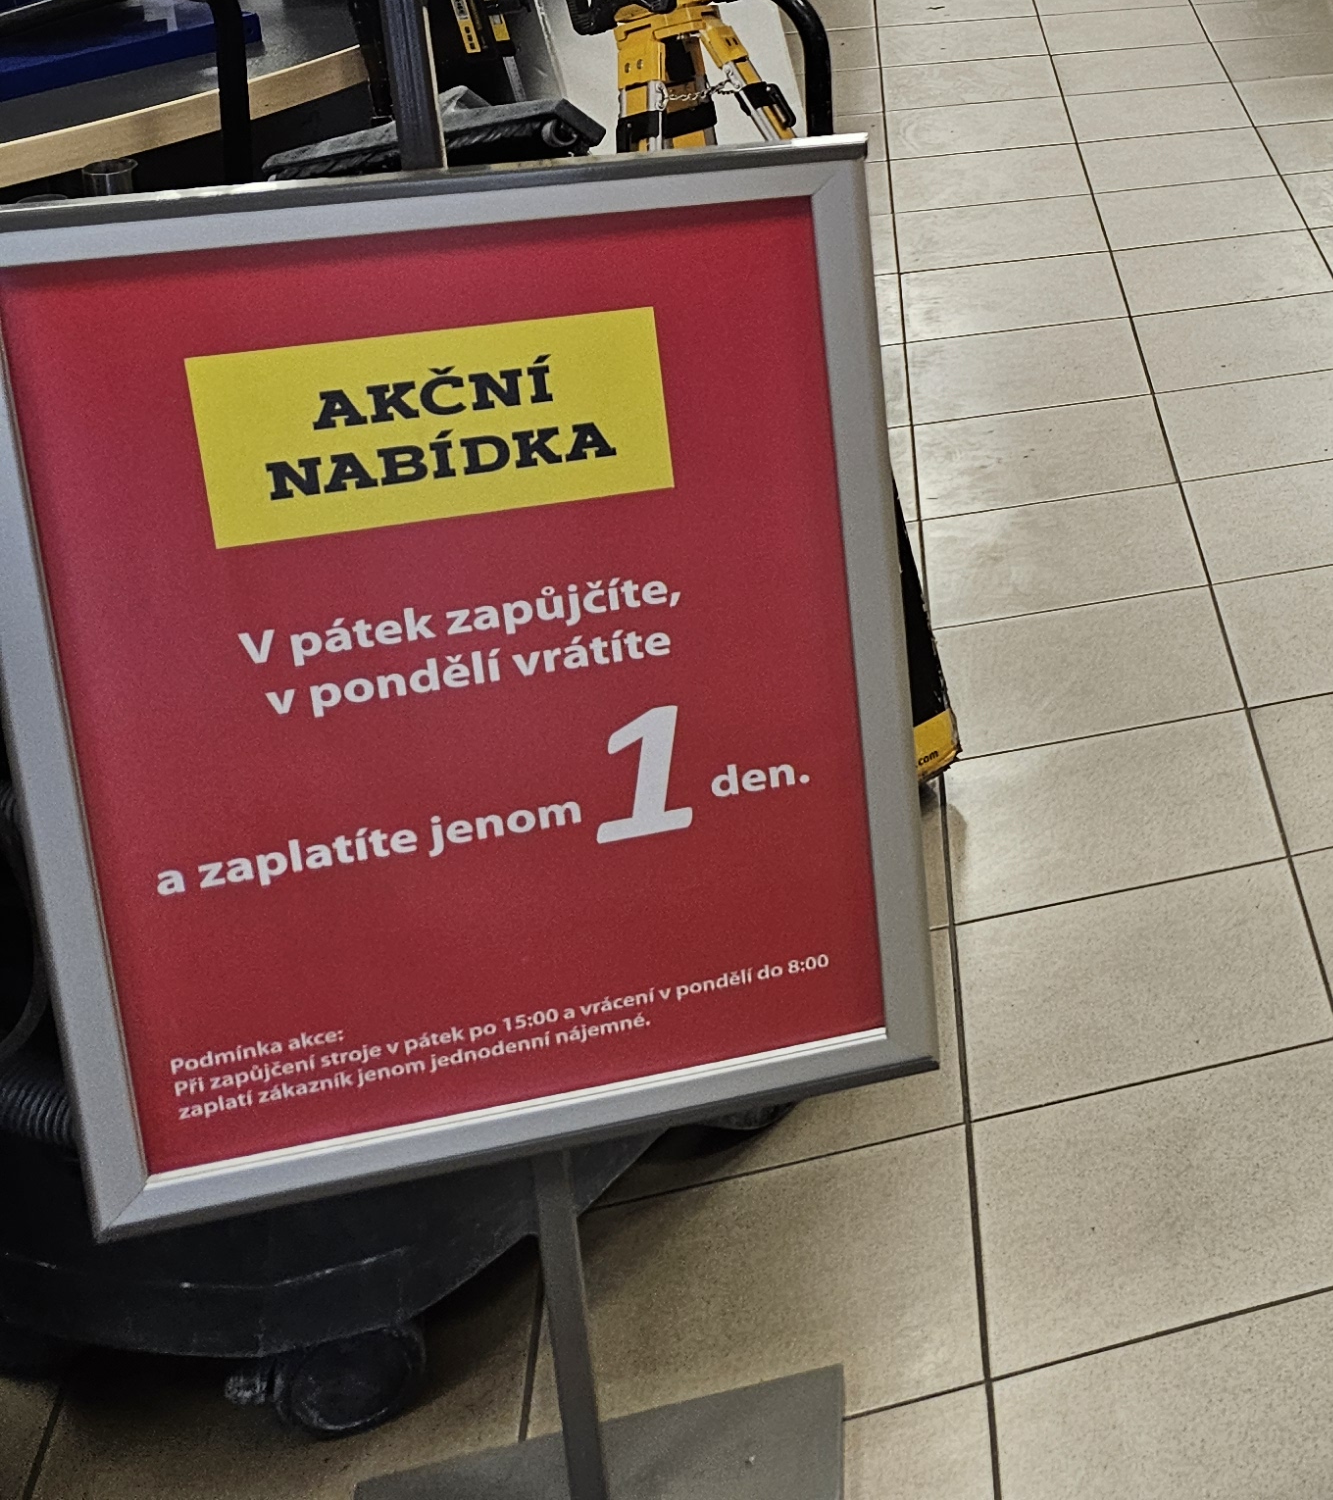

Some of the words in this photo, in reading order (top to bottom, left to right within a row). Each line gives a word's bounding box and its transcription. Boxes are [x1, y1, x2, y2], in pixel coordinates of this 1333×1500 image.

[312, 354, 555, 432] AKČNÍ
[265, 419, 618, 503] NABÍDKA
[238, 629, 276, 665] V
[291, 606, 436, 666] pátek
[446, 576, 682, 636] zapůjčíte,
[264, 687, 296, 716] v
[308, 651, 502, 717] pondělí
[511, 627, 673, 680] vrátíte
[156, 867, 185, 897] a
[199, 823, 419, 891] zaplatíte
[428, 800, 582, 857] jenom
[597, 704, 695, 845] 1
[710, 761, 811, 799] den.
[170, 1040, 283, 1075] Podmínka
[288, 1028, 345, 1051] akce:
[174, 1079, 205, 1097] Při
[210, 1057, 316, 1088] zapůjčení
[320, 1045, 383, 1069] stroje
[385, 1041, 400, 1055] v
[403, 1027, 465, 1055] pátek
[468, 1023, 497, 1043] po
[502, 1008, 560, 1033] 15:00
[563, 1005, 576, 1020] a
[579, 988, 655, 1017] vrácení
[658, 987, 672, 1001] v
[675, 967, 753, 1001] pondělí
[756, 964, 784, 981] do
[787, 953, 830, 975] 8:00
[178, 1090, 253, 1121] zaplatí
[258, 1071, 354, 1104] zákazník
[356, 1057, 426, 1089] jenom
[429, 1031, 551, 1073] jednodenní
[555, 1015, 652, 1044] nájemné.
